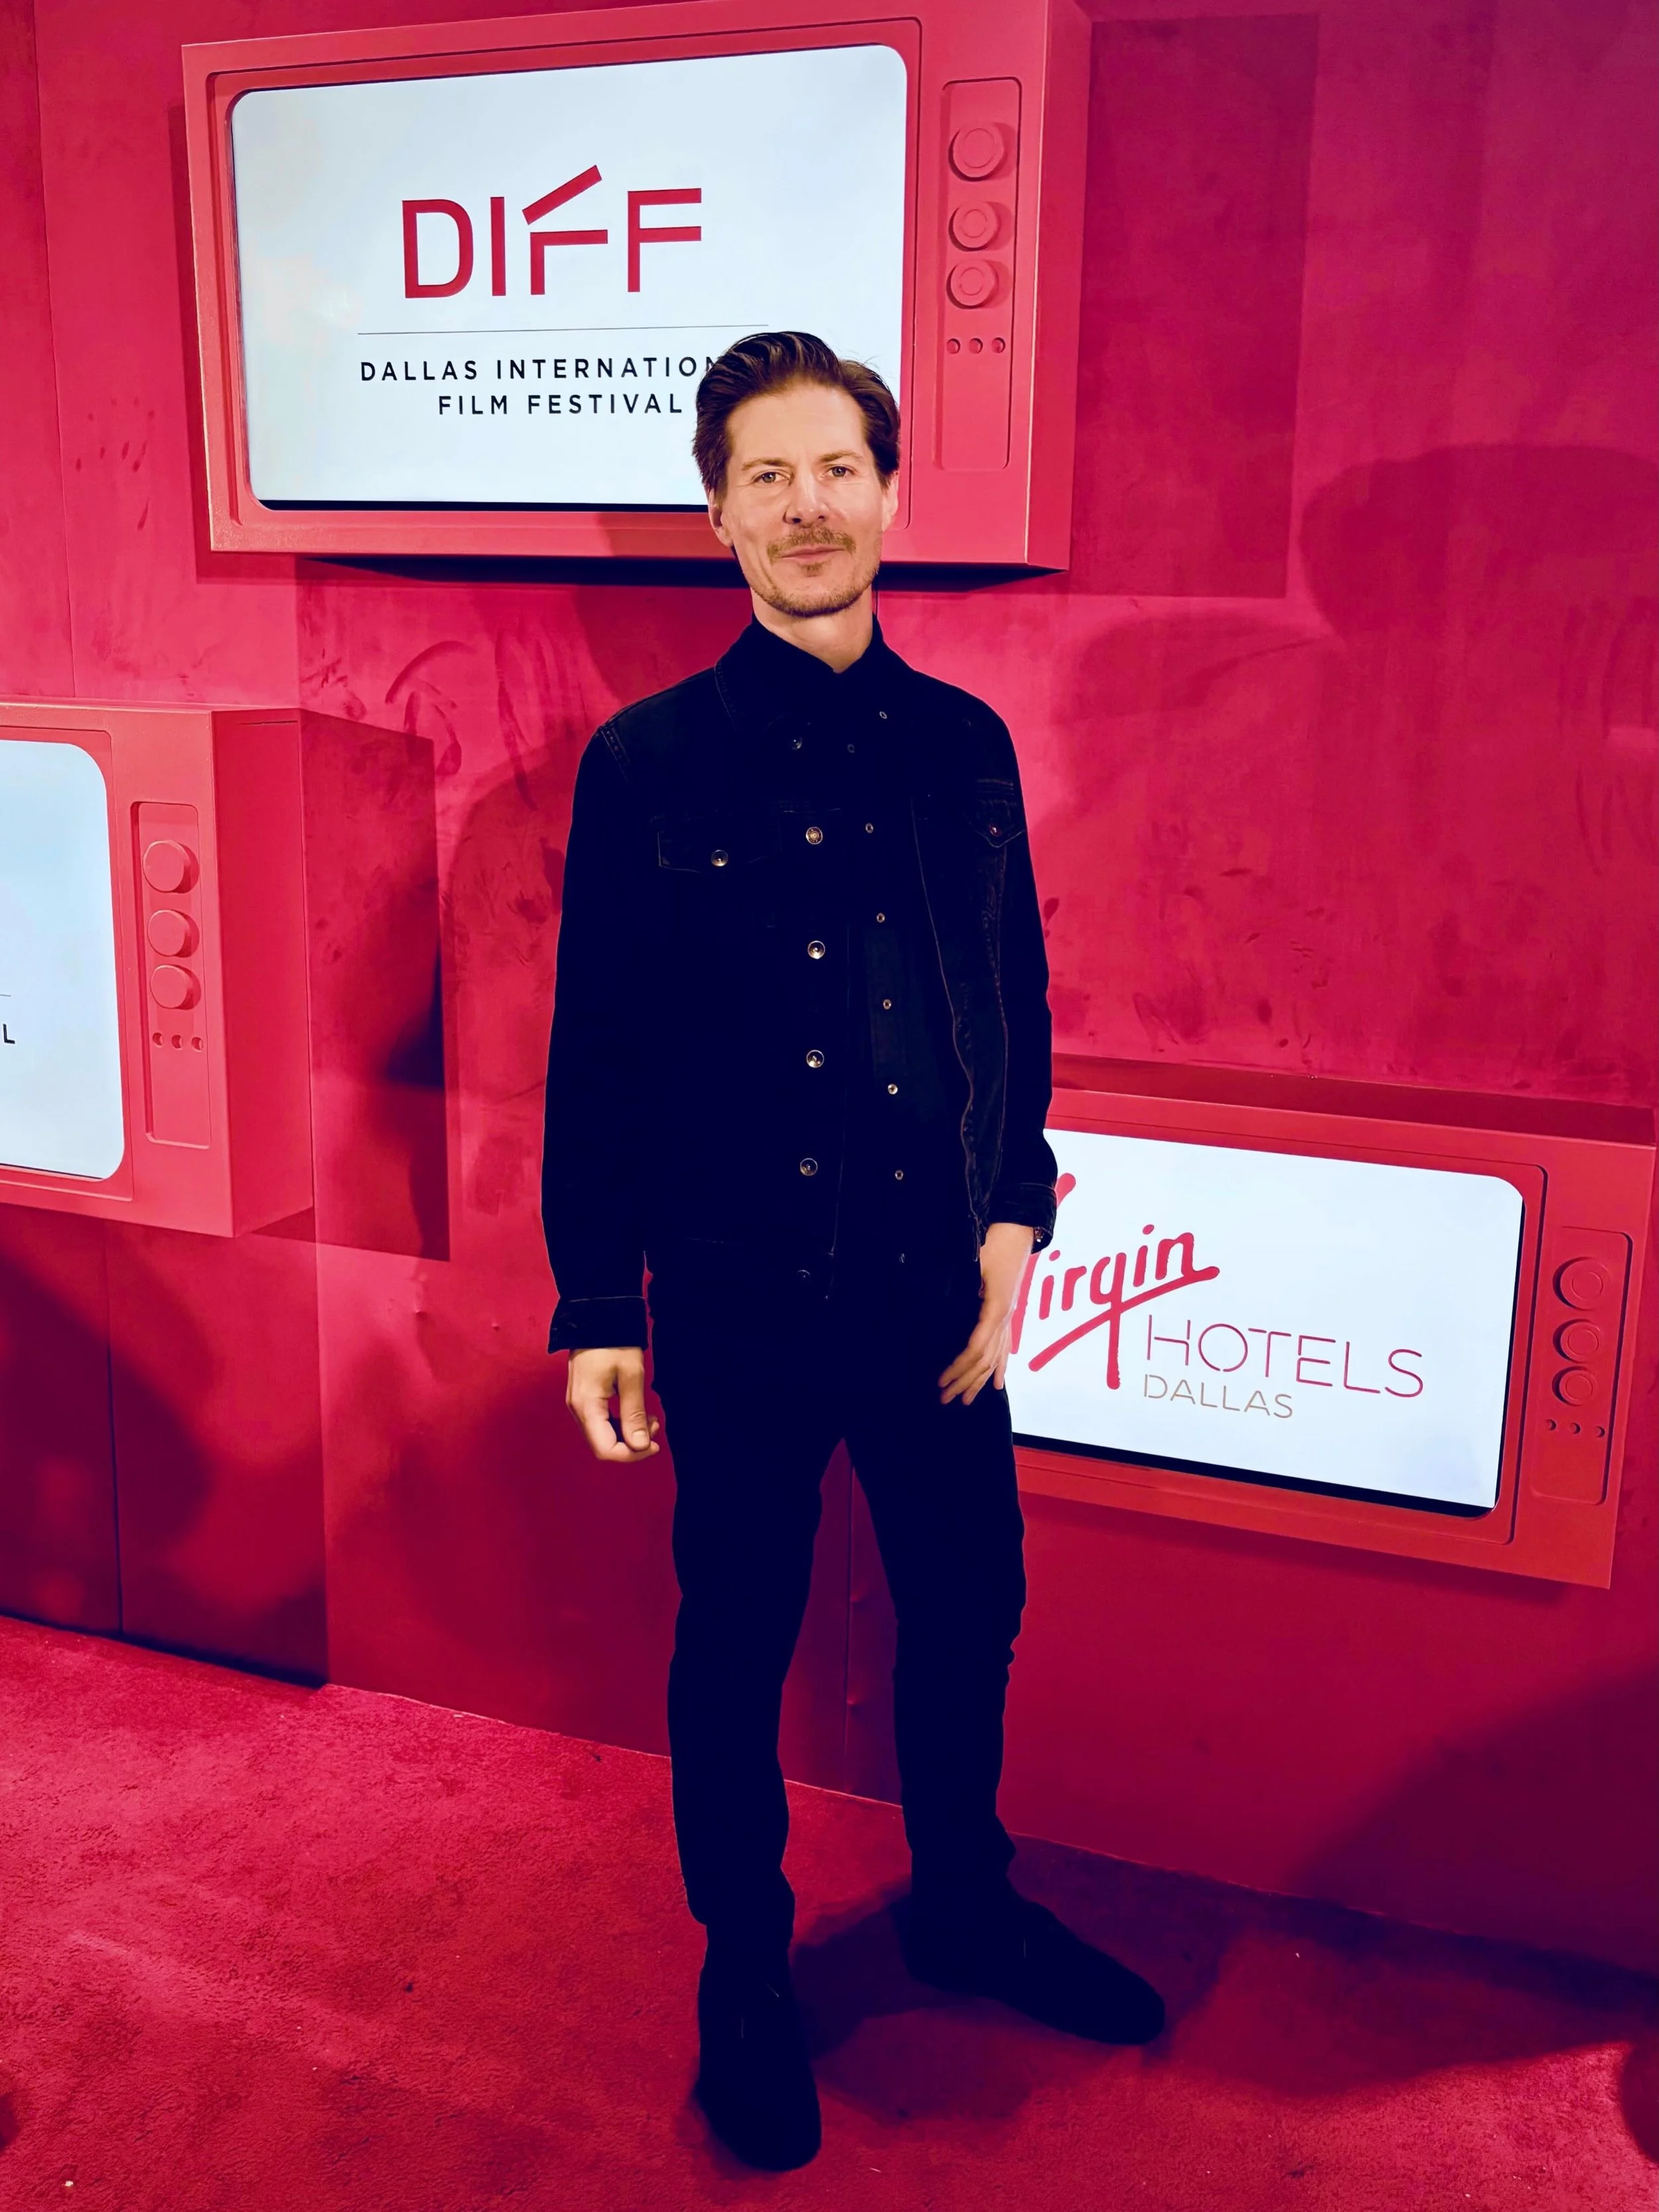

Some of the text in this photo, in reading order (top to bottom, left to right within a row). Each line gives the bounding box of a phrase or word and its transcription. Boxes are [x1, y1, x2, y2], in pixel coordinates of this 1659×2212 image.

[401, 164, 702, 299] DIFF
[360, 360, 477, 381] DALLAS
[438, 393, 682, 415] FILM FESTIVAL
[1147, 1314, 1423, 1398] HOTELS
[1143, 1373, 1293, 1418] DALLAS
